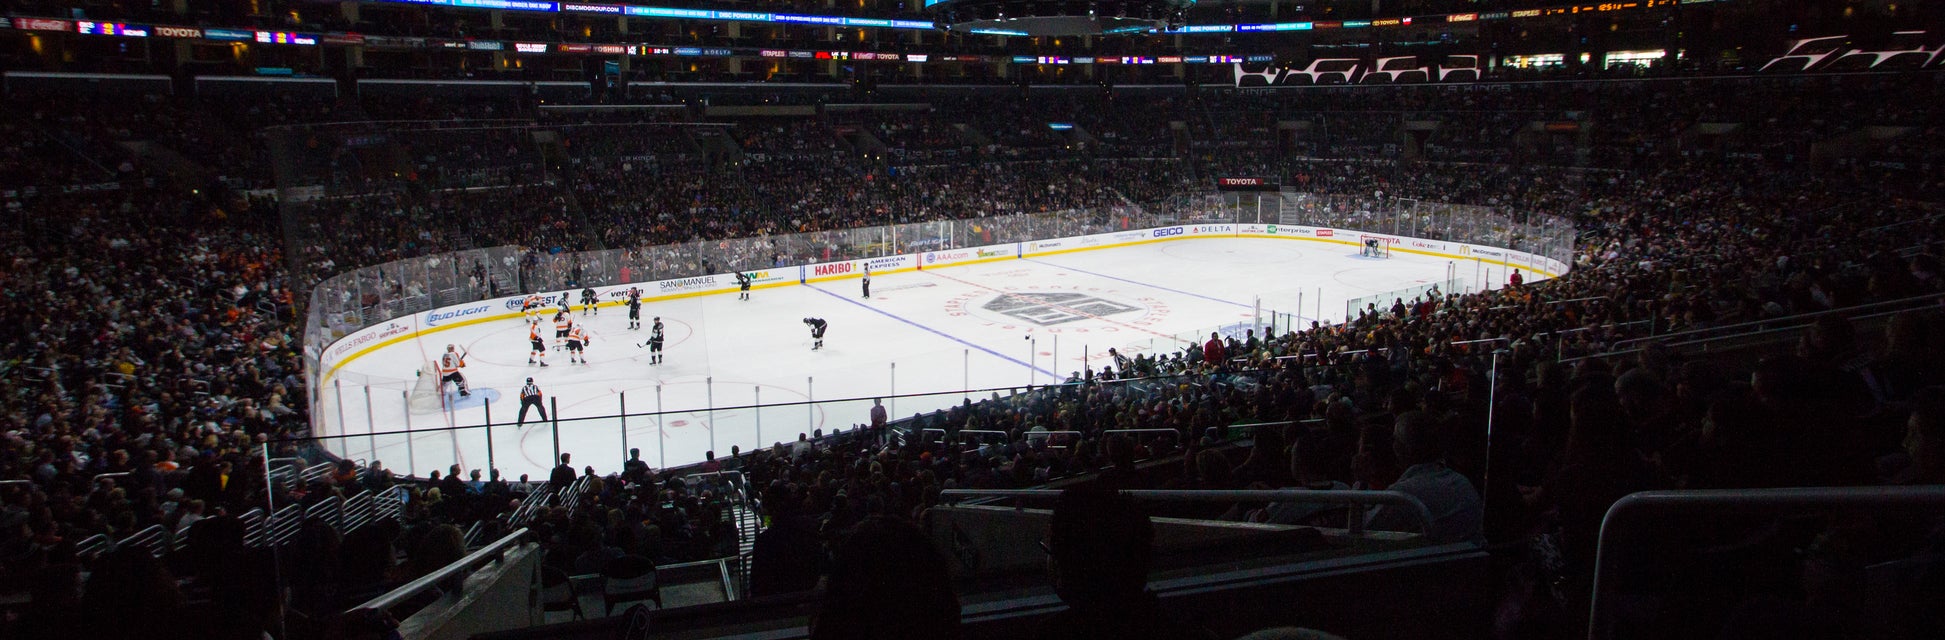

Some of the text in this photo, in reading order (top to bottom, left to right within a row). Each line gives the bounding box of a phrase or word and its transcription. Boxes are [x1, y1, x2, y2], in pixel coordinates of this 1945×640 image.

[155, 27, 202, 38] TOYOTA
[1153, 227, 1184, 237] GEICO
[870, 256, 906, 264] AMERICAN
[937, 251, 968, 261] AAA.com
[815, 262, 851, 276] HARIBO
[660, 280, 677, 289] SAN
[684, 276, 716, 286] MANUEL
[611, 287, 644, 298] verizn
[511, 298, 524, 306] FOX
[430, 305, 491, 323] BUD LIGHT
[353, 331, 376, 347] FARGO
